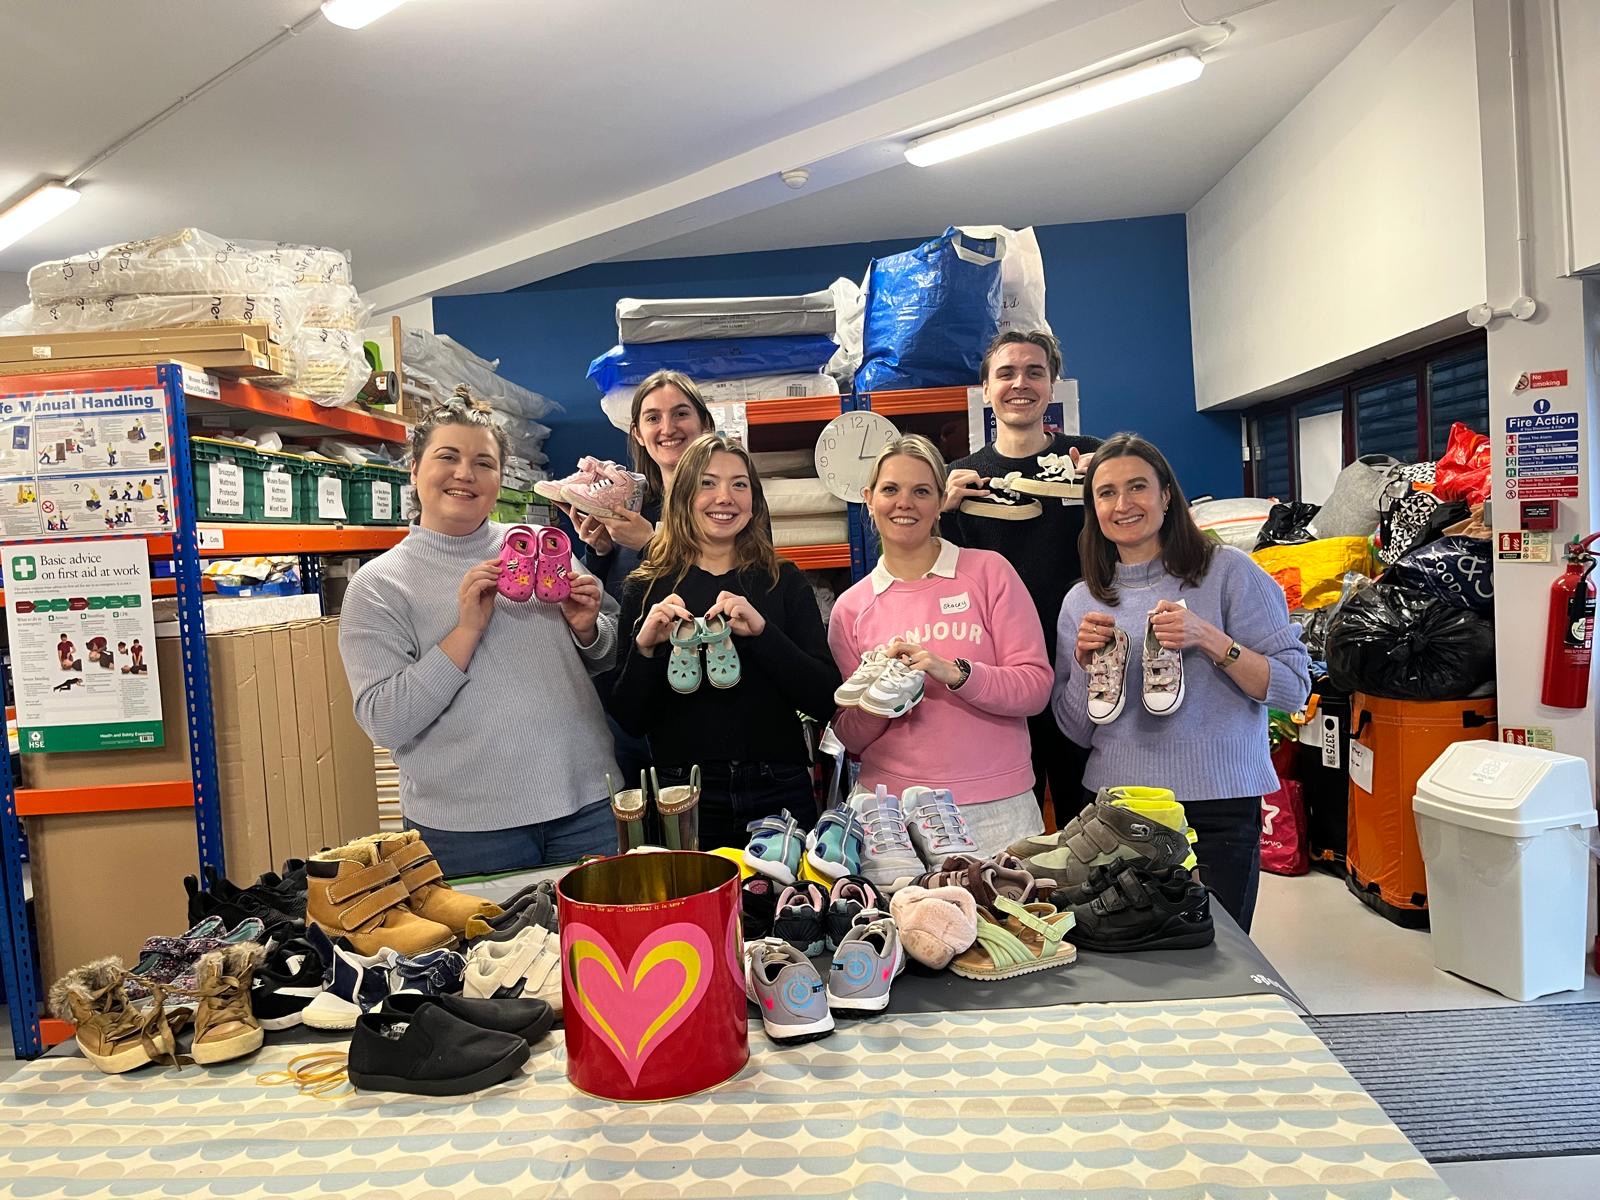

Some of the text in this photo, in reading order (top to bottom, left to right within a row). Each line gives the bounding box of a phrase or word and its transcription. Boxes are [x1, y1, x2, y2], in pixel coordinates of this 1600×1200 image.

[81, 394, 154, 409] Handling
[850, 416, 864, 429] 12
[872, 418, 878, 431] 1
[1509, 415, 1575, 428] Fire Action
[835, 423, 845, 436] 11
[884, 430, 894, 442] 2
[822, 438, 836, 451] 10
[820, 456, 829, 468] 9
[841, 480, 850, 495] 7
[40, 552, 102, 566] Basic advice
[41, 563, 140, 580] on first aid at work
[888, 621, 983, 645] NJOUR
[28, 741, 45, 749] HSE
[1325, 733, 1335, 755] 3375
